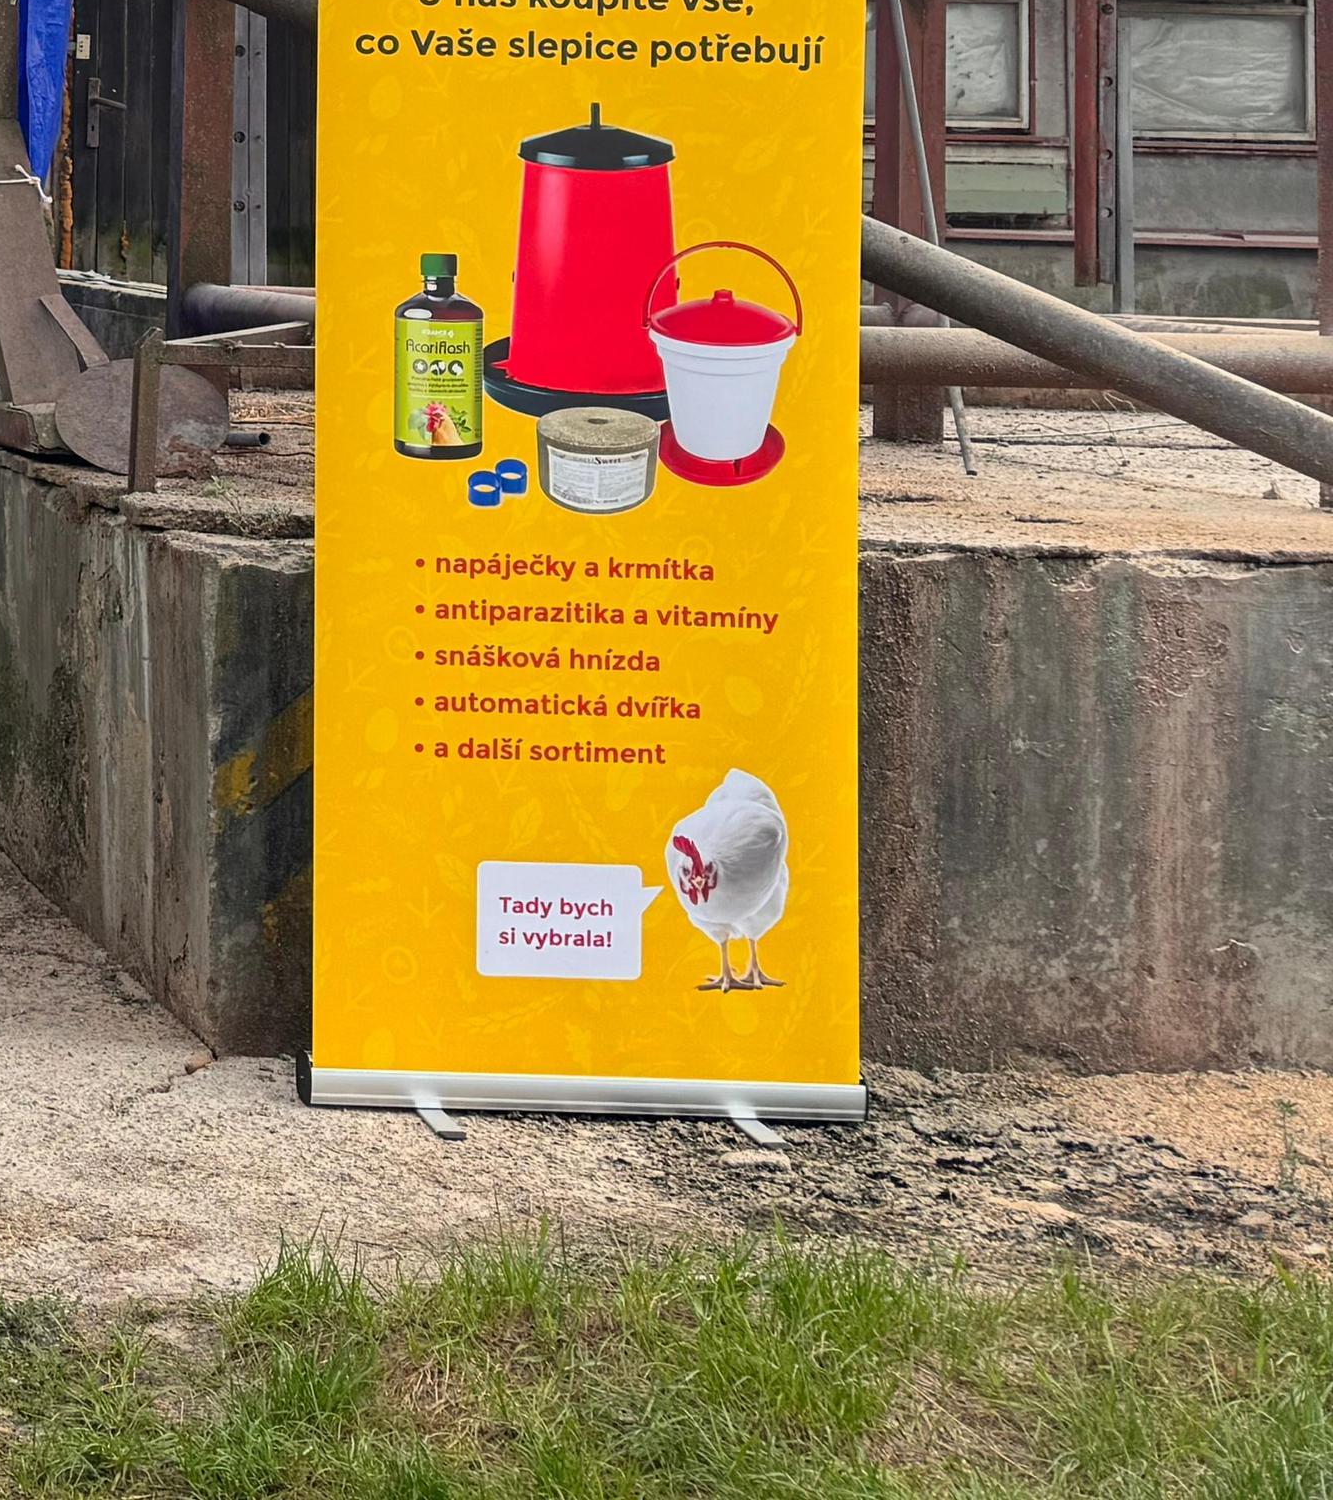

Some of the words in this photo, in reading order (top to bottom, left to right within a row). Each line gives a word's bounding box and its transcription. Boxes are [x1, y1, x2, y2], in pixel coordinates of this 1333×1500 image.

[355, 34, 400, 56] co
[411, 28, 495, 59] Vaše
[508, 30, 638, 65] slepice
[650, 33, 825, 71] potřebují
[436, 554, 577, 582] napáječky
[584, 561, 599, 579] a
[608, 557, 715, 582] krmítka
[435, 600, 625, 626] antiparazitika
[633, 609, 648, 626] a
[657, 607, 779, 634] vitamíny
[435, 645, 560, 670] snášková
[570, 650, 661, 672] hnízda
[434, 693, 608, 717] automatická
[617, 695, 702, 720] dvířka
[434, 743, 449, 760] a
[457, 738, 523, 762] další
[530, 740, 667, 765] sortiment
[500, 897, 553, 919] Tady
[559, 897, 614, 920] bych
[498, 928, 516, 946] si
[523, 929, 613, 950] vybrala!
